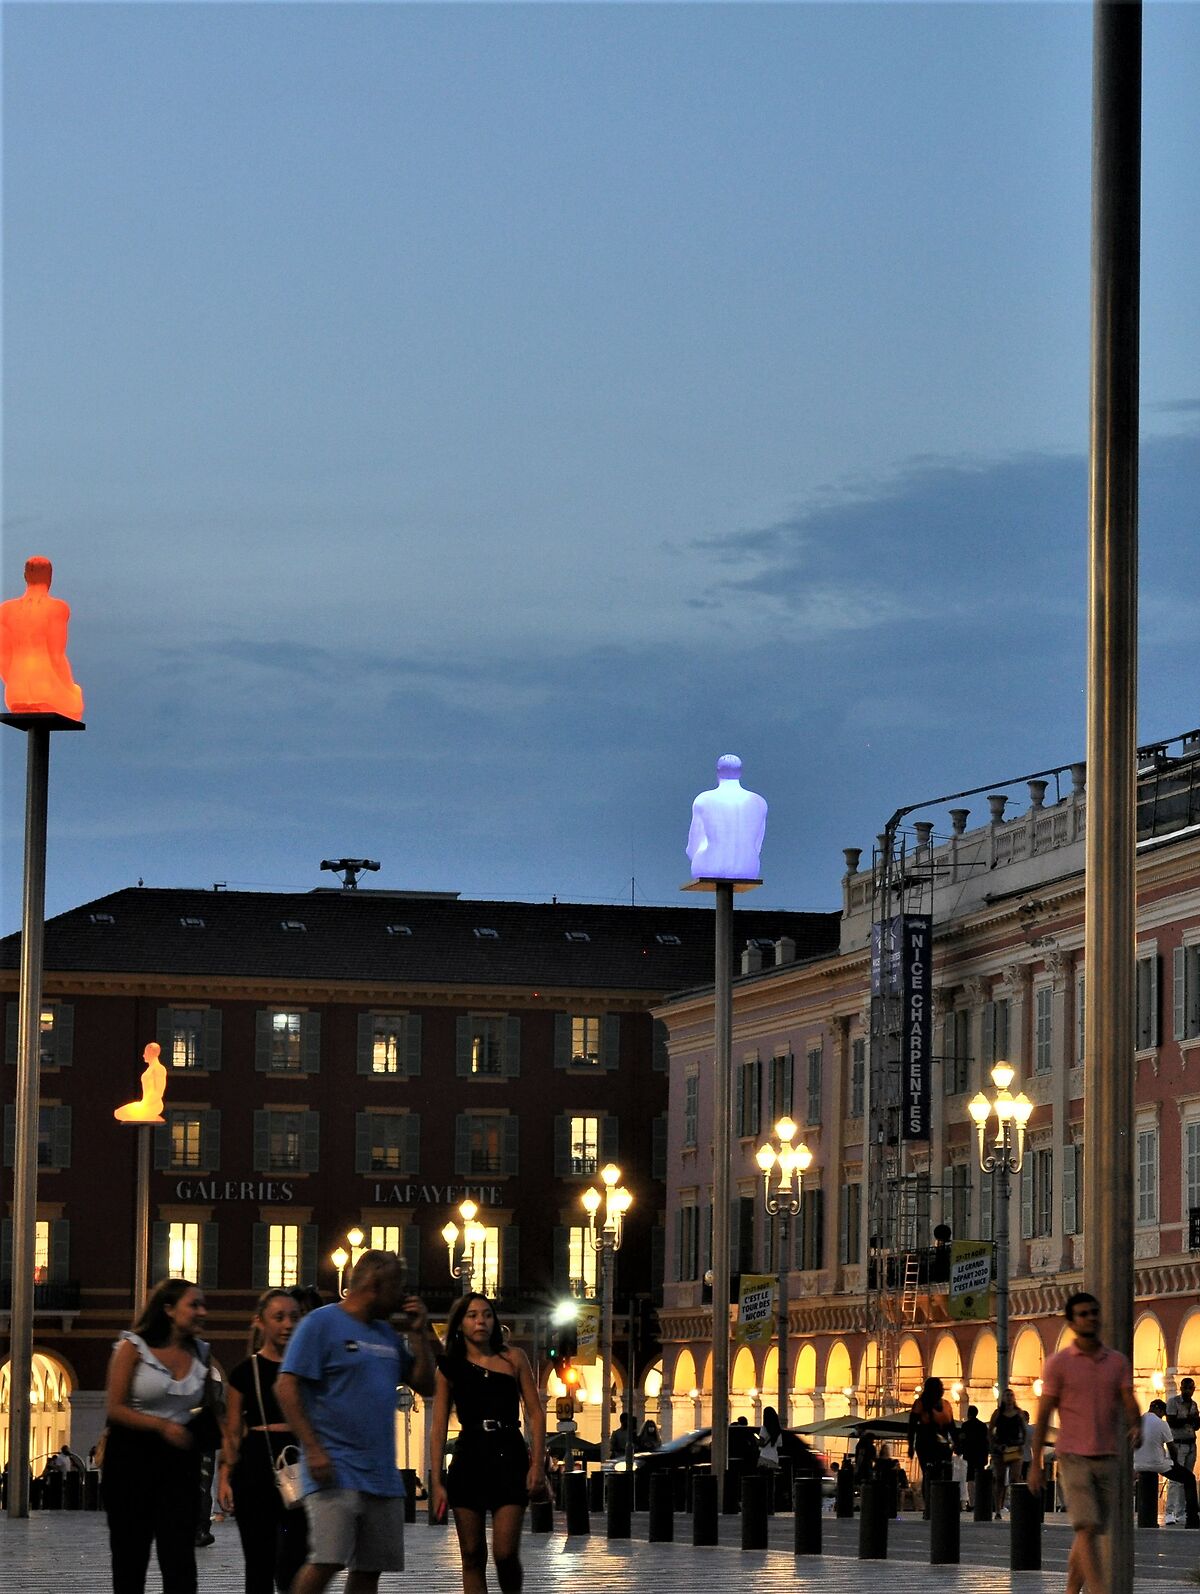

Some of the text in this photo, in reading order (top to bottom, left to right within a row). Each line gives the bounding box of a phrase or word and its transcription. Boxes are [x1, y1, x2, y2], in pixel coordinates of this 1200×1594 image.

[909, 934, 924, 1134] NICE CHARPENTES
[175, 1180, 504, 1205] GALERIES LAFAYETTE
[965, 1260, 984, 1270] GRAND
[744, 1291, 769, 1304] C'EST LE
[742, 1299, 770, 1313] TOUR DES
[557, 1403, 570, 1414] 30
